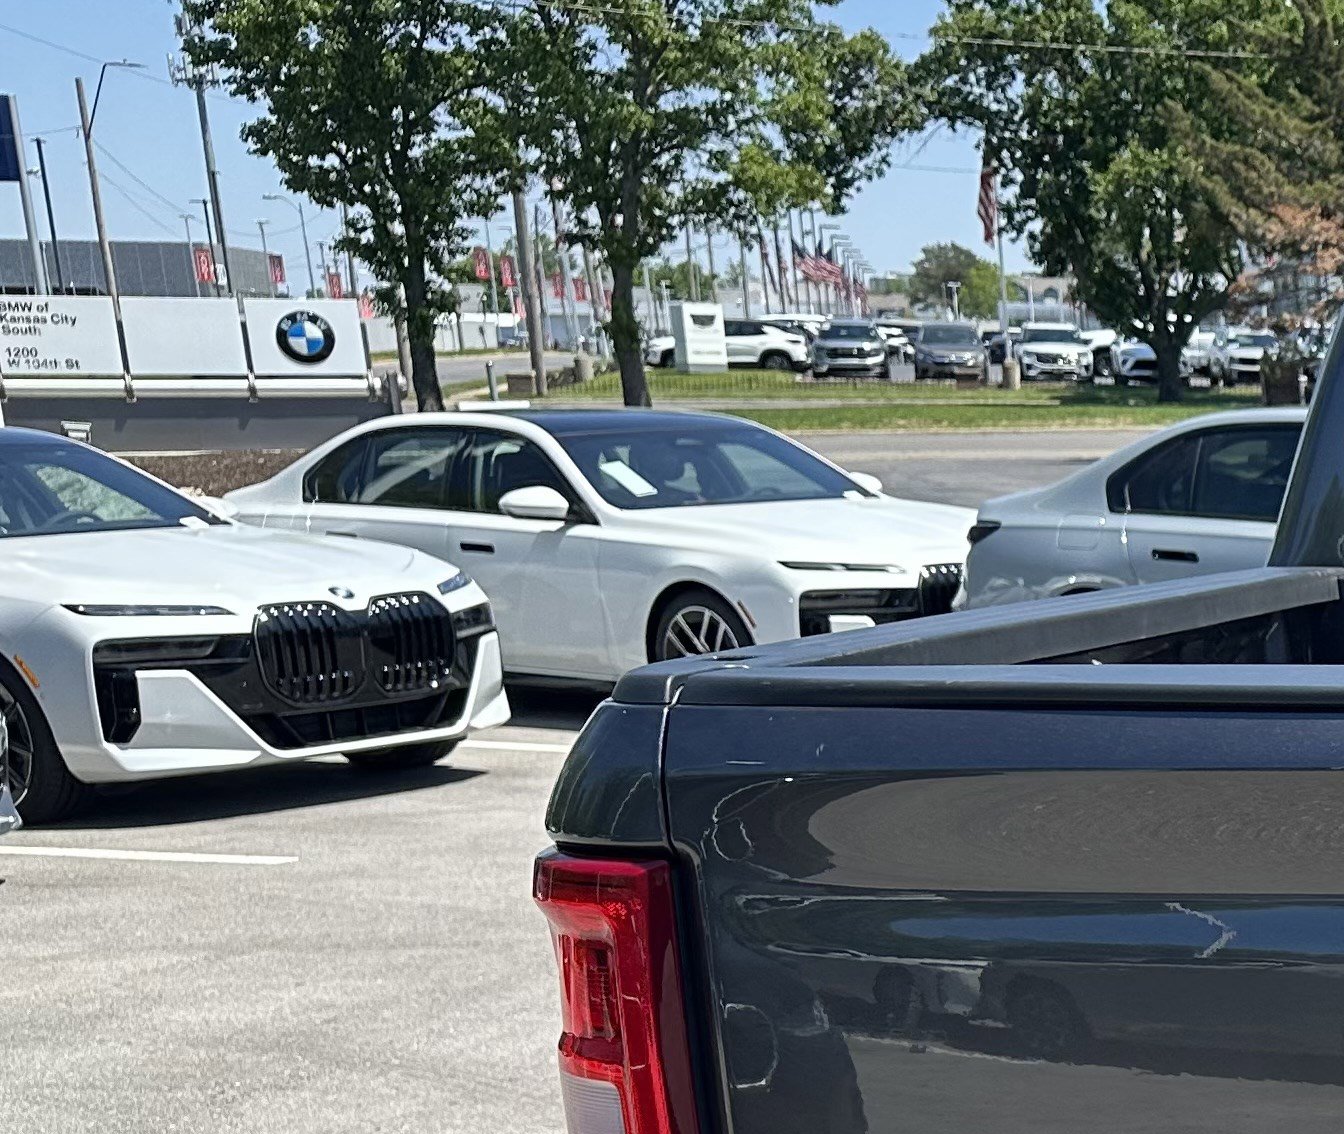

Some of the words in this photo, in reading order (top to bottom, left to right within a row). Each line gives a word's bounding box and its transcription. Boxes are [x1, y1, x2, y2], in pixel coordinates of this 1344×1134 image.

[0, 302, 32, 313] BMW
[36, 302, 49, 313] of
[0, 313, 48, 325] Kansas
[50, 313, 77, 327] City
[2, 324, 42, 336] South
[6, 347, 38, 358] 1200
[7, 359, 20, 368] W
[65, 359, 80, 370] St
